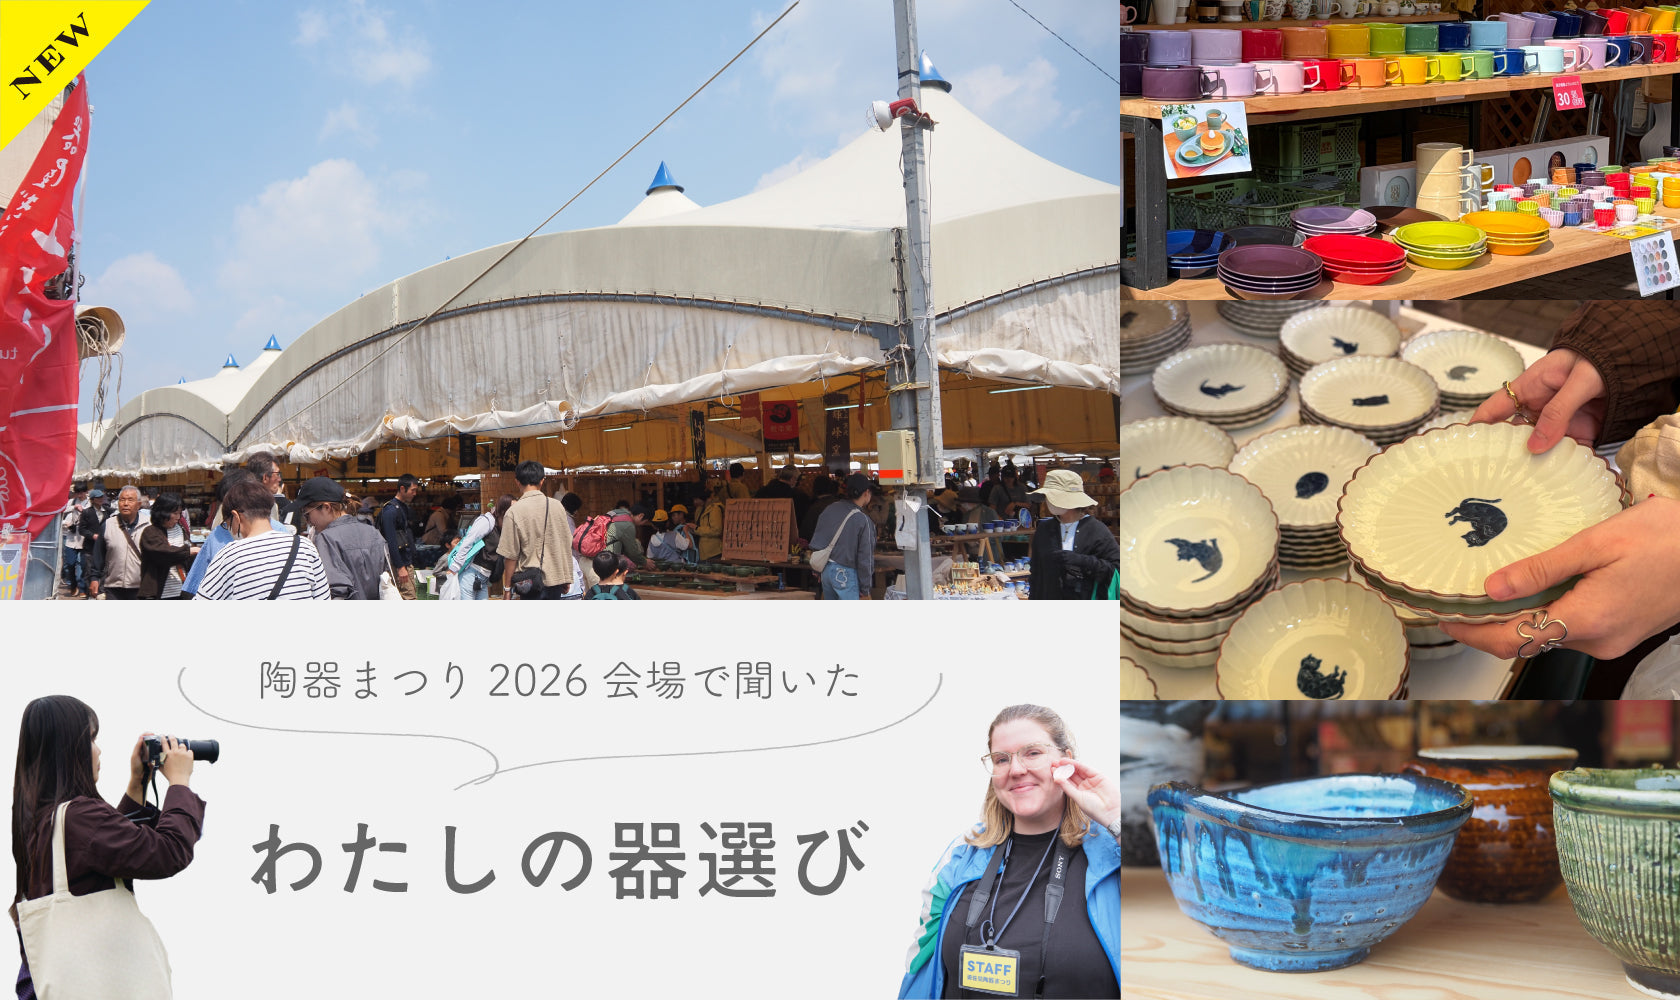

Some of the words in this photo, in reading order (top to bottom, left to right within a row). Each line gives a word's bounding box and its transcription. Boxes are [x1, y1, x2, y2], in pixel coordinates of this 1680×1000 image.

[1557, 92, 1571, 106] 30
[1055, 855, 1065, 879] SONY
[967, 960, 1011, 976] STAFF
